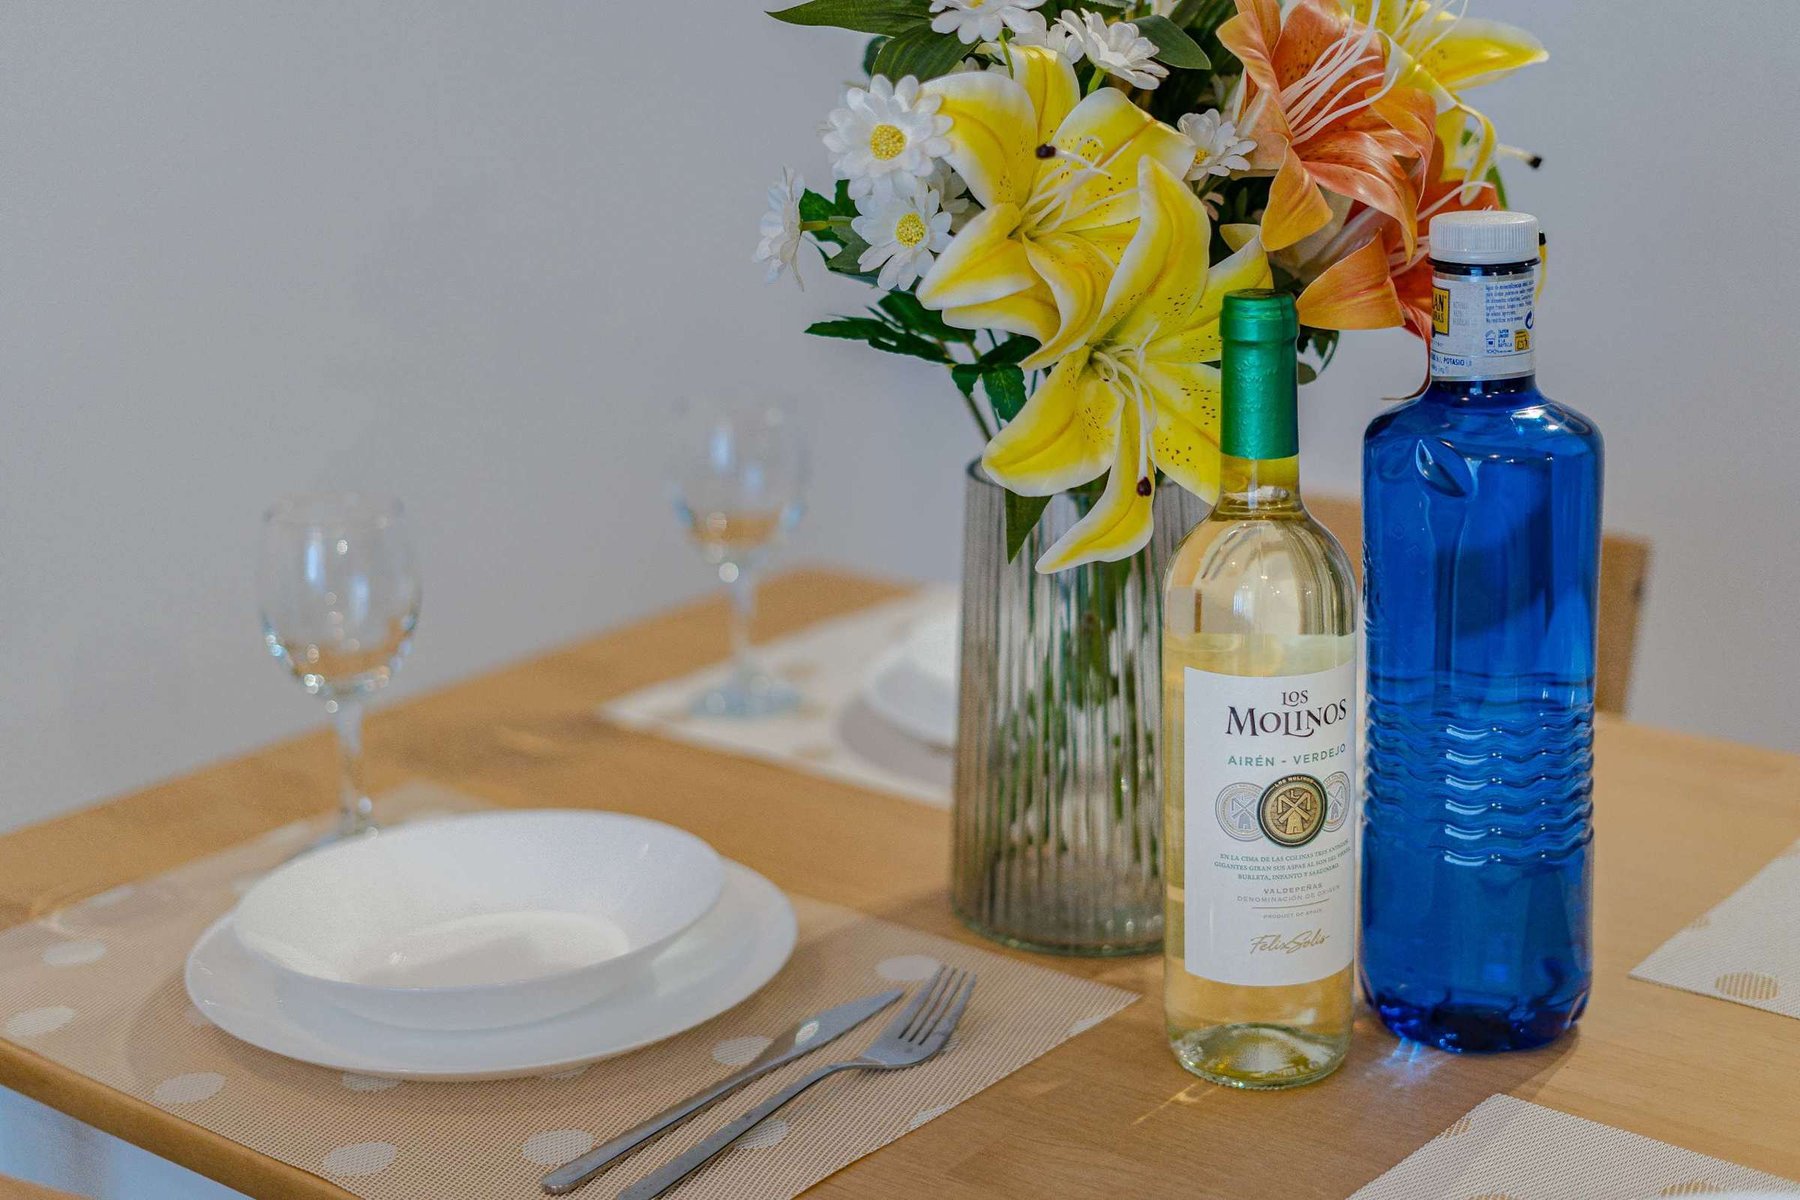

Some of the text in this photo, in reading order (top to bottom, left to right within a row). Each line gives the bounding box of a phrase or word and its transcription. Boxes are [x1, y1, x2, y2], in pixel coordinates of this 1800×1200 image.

[1281, 689, 1308, 707] LOS
[1225, 698, 1346, 738] MOLINOS
[1227, 754, 1275, 766] AIRÉN
[1293, 743, 1346, 764] VERDEJO
[1285, 853, 1313, 861] COLINAS
[1214, 861, 1247, 871] GIGANTES
[1263, 883, 1323, 894] VALDEPEÑAS
[1237, 894, 1303, 903] DENOMINACIÓN
